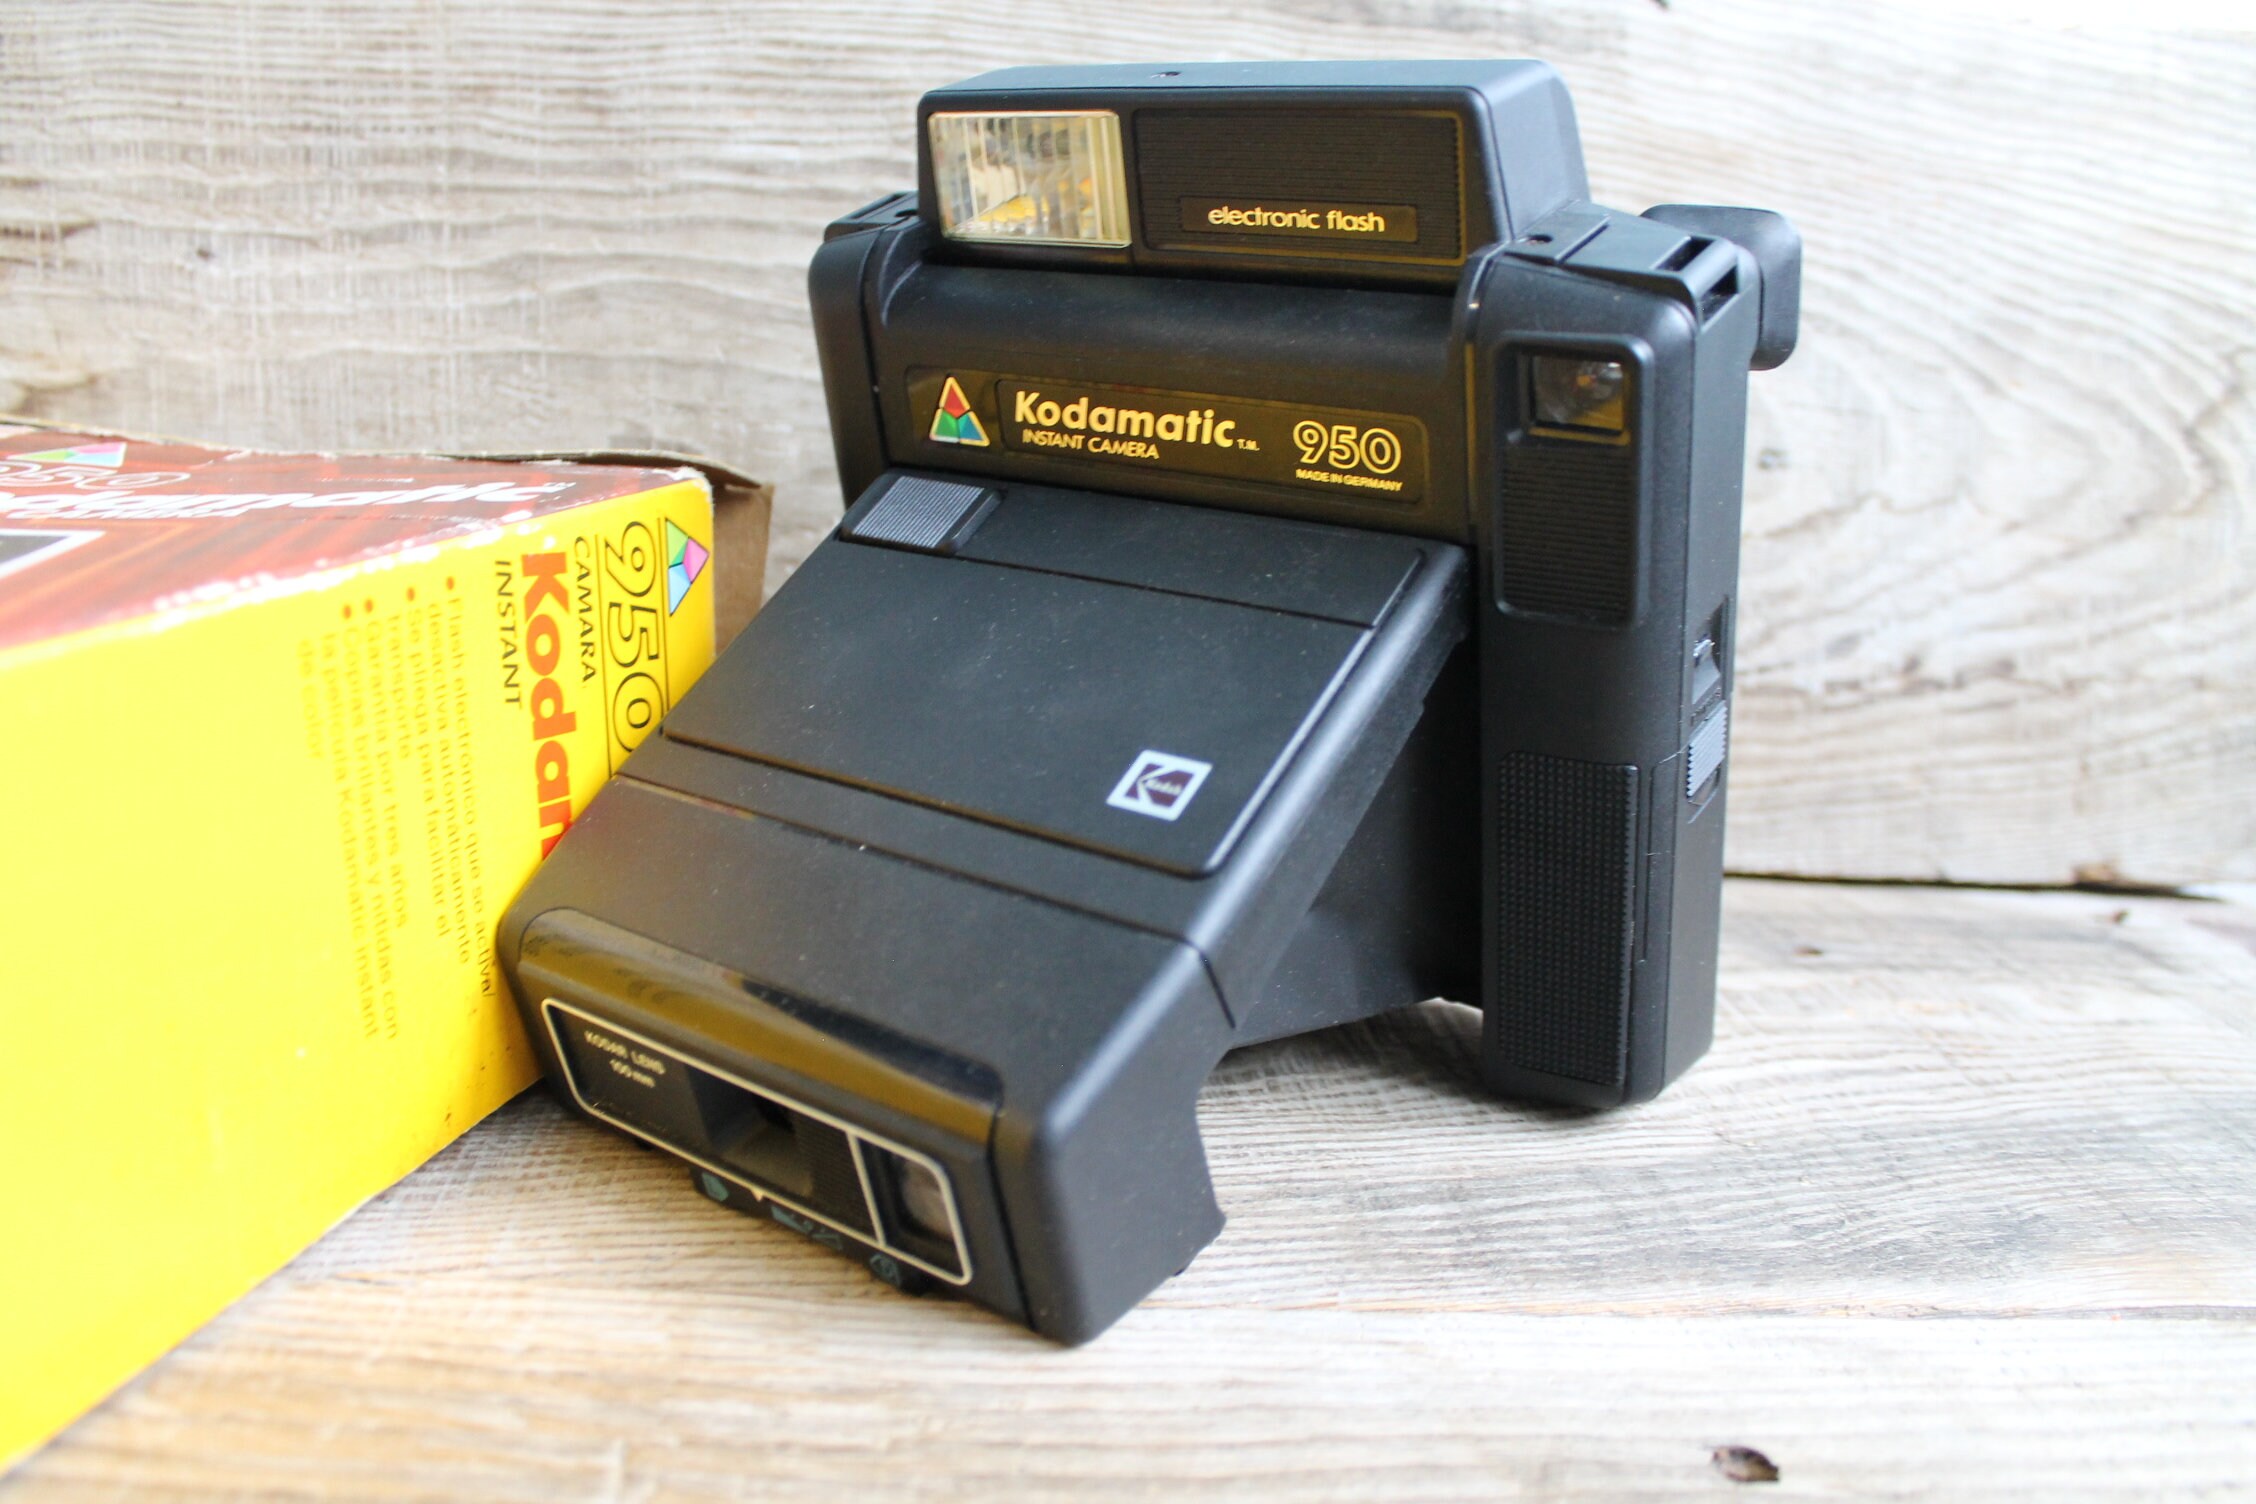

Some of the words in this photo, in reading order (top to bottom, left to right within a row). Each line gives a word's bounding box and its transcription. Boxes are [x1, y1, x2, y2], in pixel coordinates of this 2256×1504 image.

[1208, 205, 1320, 230] electronic
[1326, 209, 1385, 232] flash
[1014, 390, 1236, 447] Kodamatic
[1022, 429, 1086, 450] INSTANT
[1087, 436, 1160, 459] CAMERA
[1293, 420, 1402, 475] 950
[1296, 468, 1330, 482] MADE
[1329, 473, 1343, 484] IN
[1343, 474, 1403, 492] GERMANY
[407, 607, 423, 644] Se
[447, 597, 465, 671] Flash
[495, 560, 523, 709] INSTANT
[573, 536, 597, 684] CAMARA
[604, 520, 664, 753] 950
[386, 614, 413, 761] transporte
[408, 651, 430, 735] pliega
[427, 602, 450, 732] desactiva
[376, 750, 394, 796] por
[416, 743, 436, 804] para
[382, 803, 400, 857] tres
[425, 808, 446, 905] facilitar
[464, 830, 482, 882] que
[337, 788, 369, 938] Kodamatic
[354, 944, 379, 1039] instant
[352, 734, 378, 868] brillantes
[381, 990, 399, 1041] con
[471, 886, 485, 914] se
[435, 914, 451, 938] el
